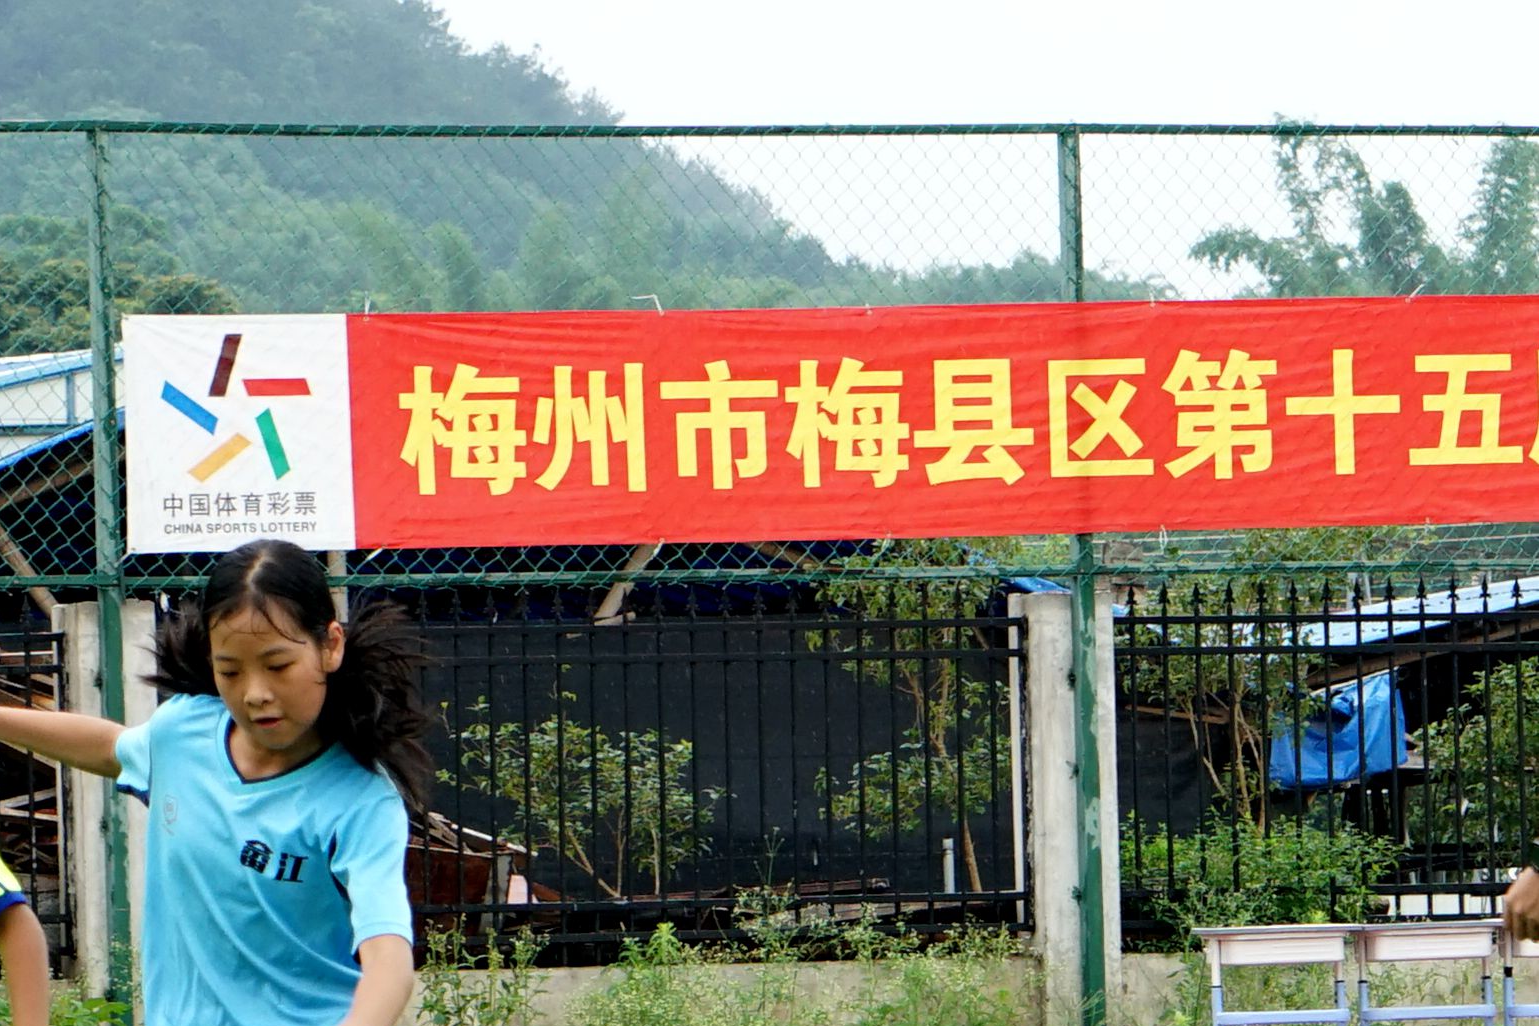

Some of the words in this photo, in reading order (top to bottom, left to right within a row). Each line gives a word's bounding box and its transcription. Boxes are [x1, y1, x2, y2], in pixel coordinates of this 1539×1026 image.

[398, 349, 1539, 496] 梅州市梅县区第十五
[162, 492, 317, 518] 中国体育彩票
[163, 523, 203, 535] CHINA
[206, 522, 257, 534] SPORTS
[261, 521, 317, 533] LOTTERY
